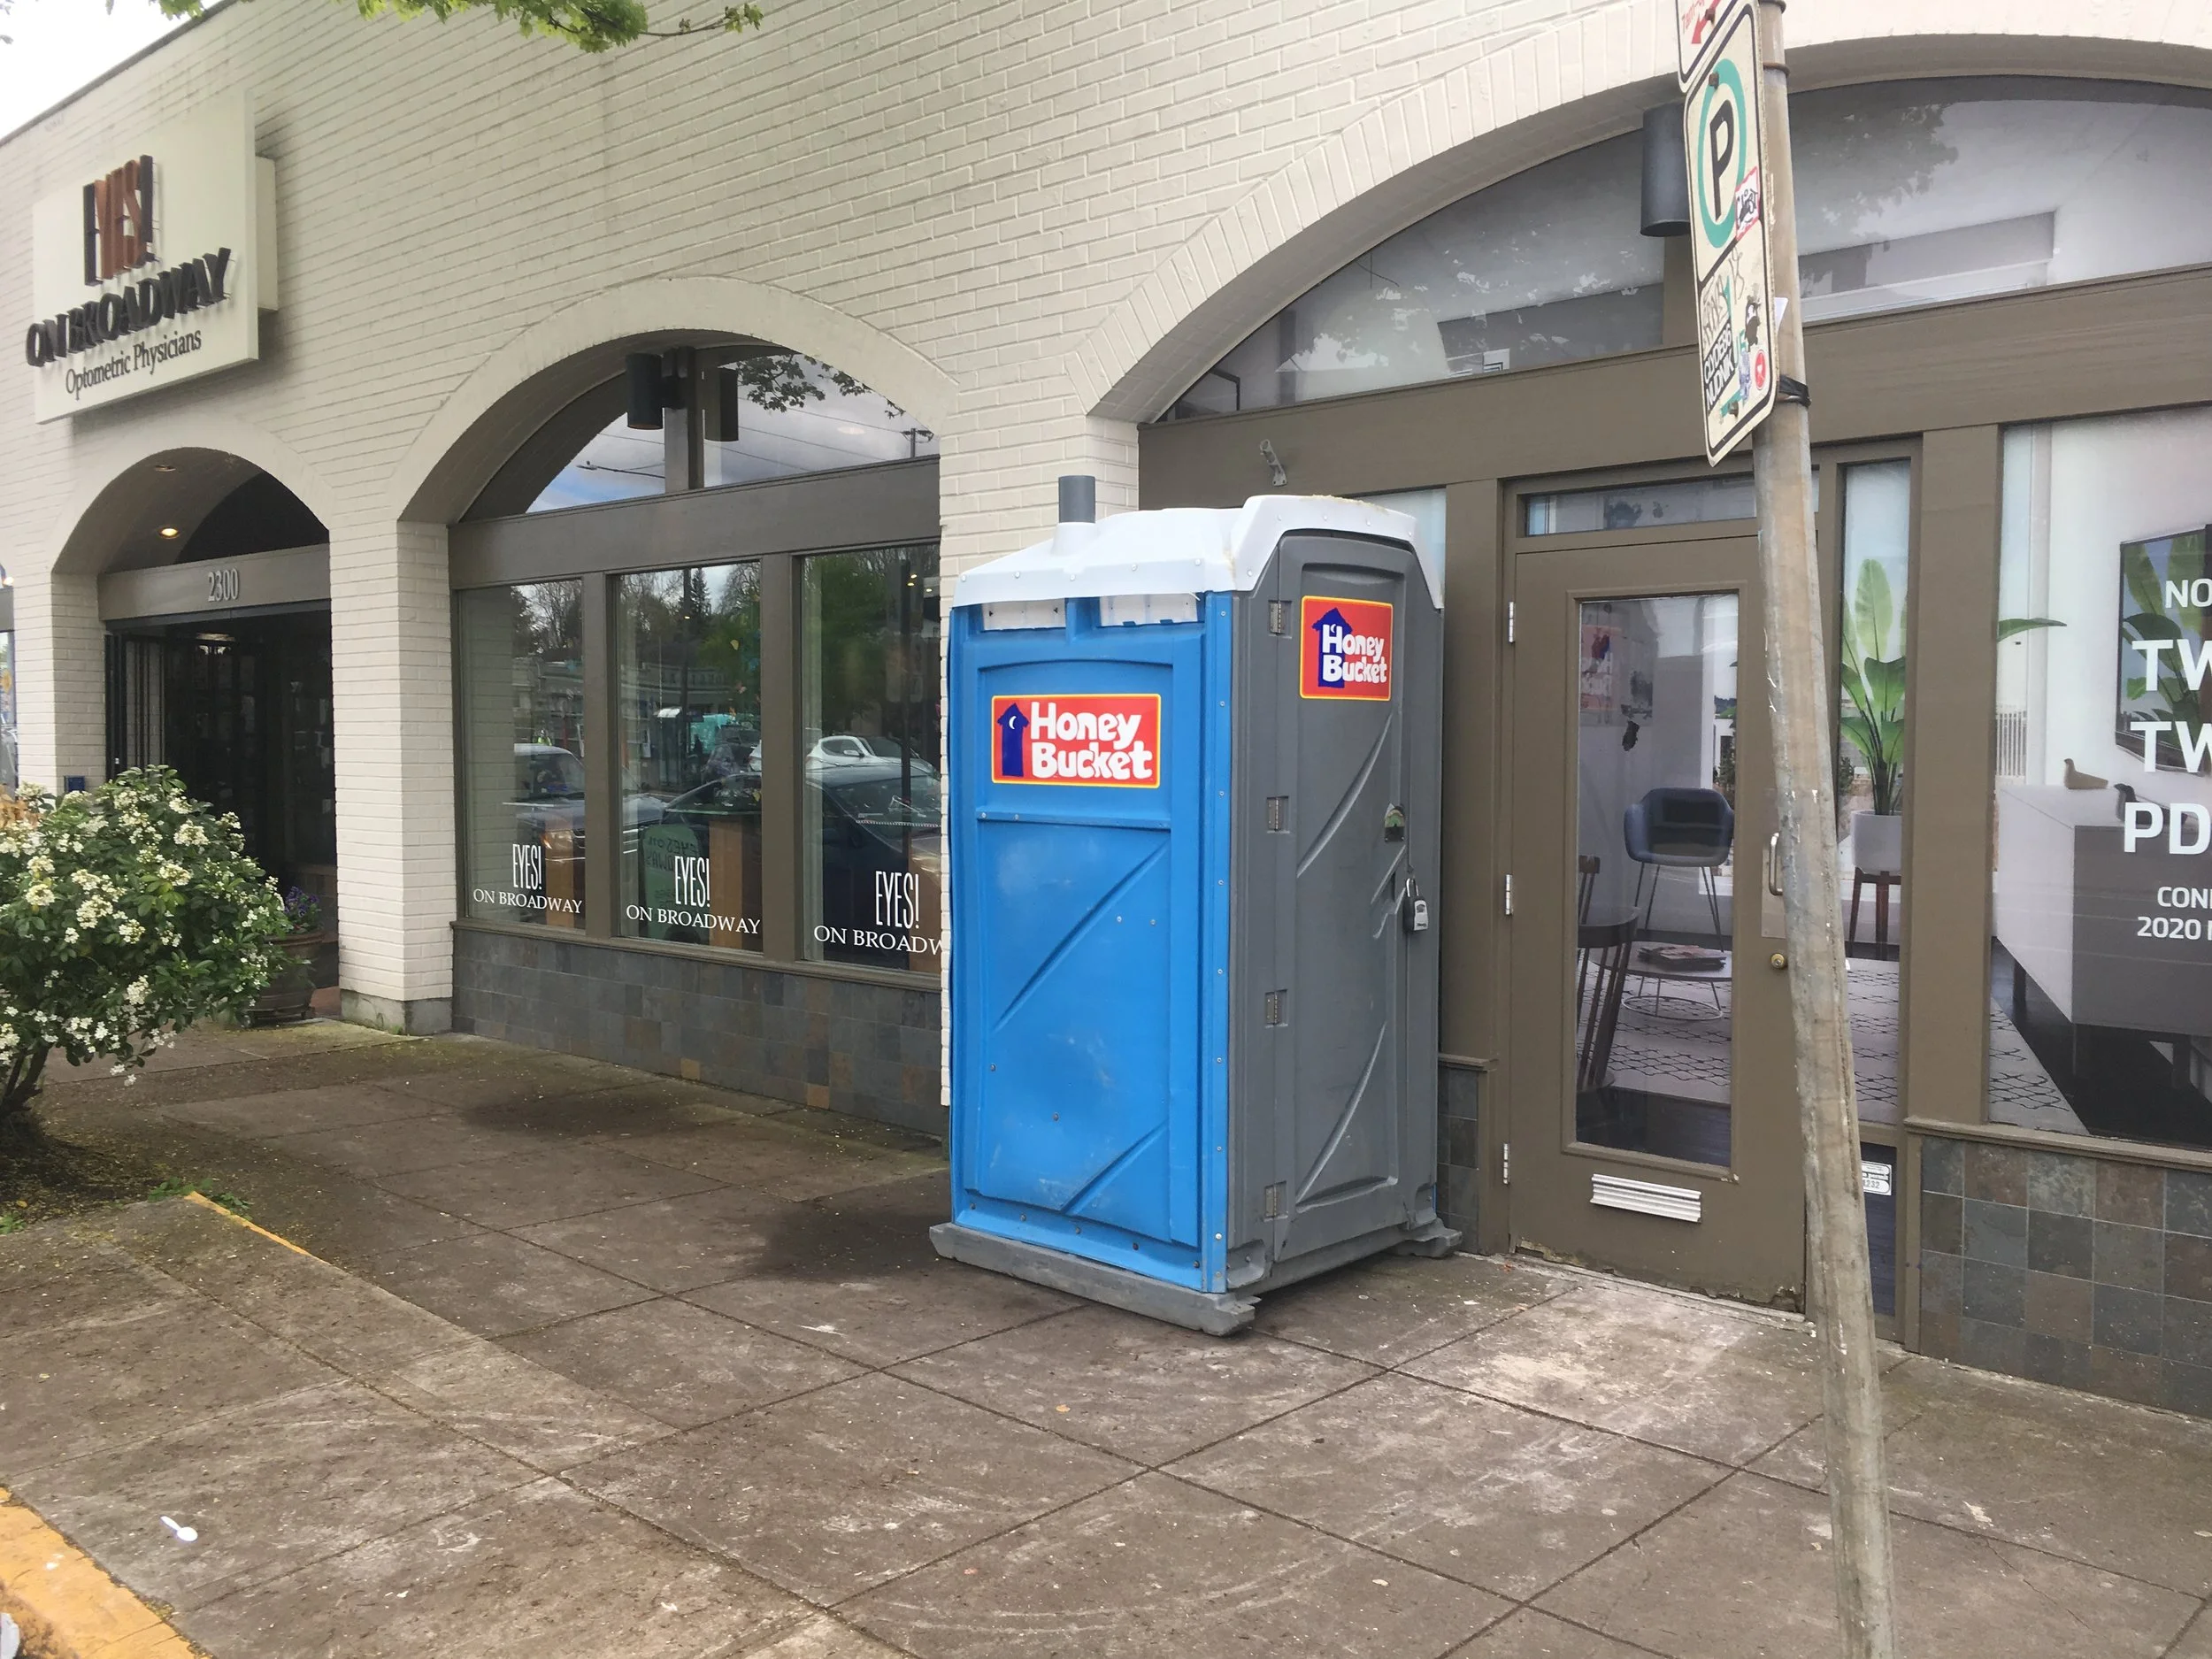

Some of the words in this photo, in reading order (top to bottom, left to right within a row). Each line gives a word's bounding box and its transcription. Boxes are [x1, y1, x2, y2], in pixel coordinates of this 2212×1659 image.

[1709, 99, 1734, 221] P
[67, 247, 232, 354] BROADWAY
[66, 350, 131, 401] Optometric
[133, 330, 202, 375] Physicians
[207, 568, 240, 603] 2300
[1322, 624, 1385, 663] Honey
[1322, 655, 1387, 684] Bucket
[1030, 701, 1142, 750] Honey
[1031, 740, 1153, 780] Bucket
[512, 843, 542, 890] EYES!
[674, 855, 710, 908] EYES!
[472, 888, 495, 903] ON
[499, 891, 583, 913] BROADWAY
[875, 871, 919, 929] EYES!
[2157, 887, 2212, 909] CON
[626, 904, 653, 922] ON
[657, 908, 761, 934] BROADWAY
[2137, 916, 2201, 940] 2020
[814, 925, 848, 945] ON
[852, 929, 941, 956] BROADW
